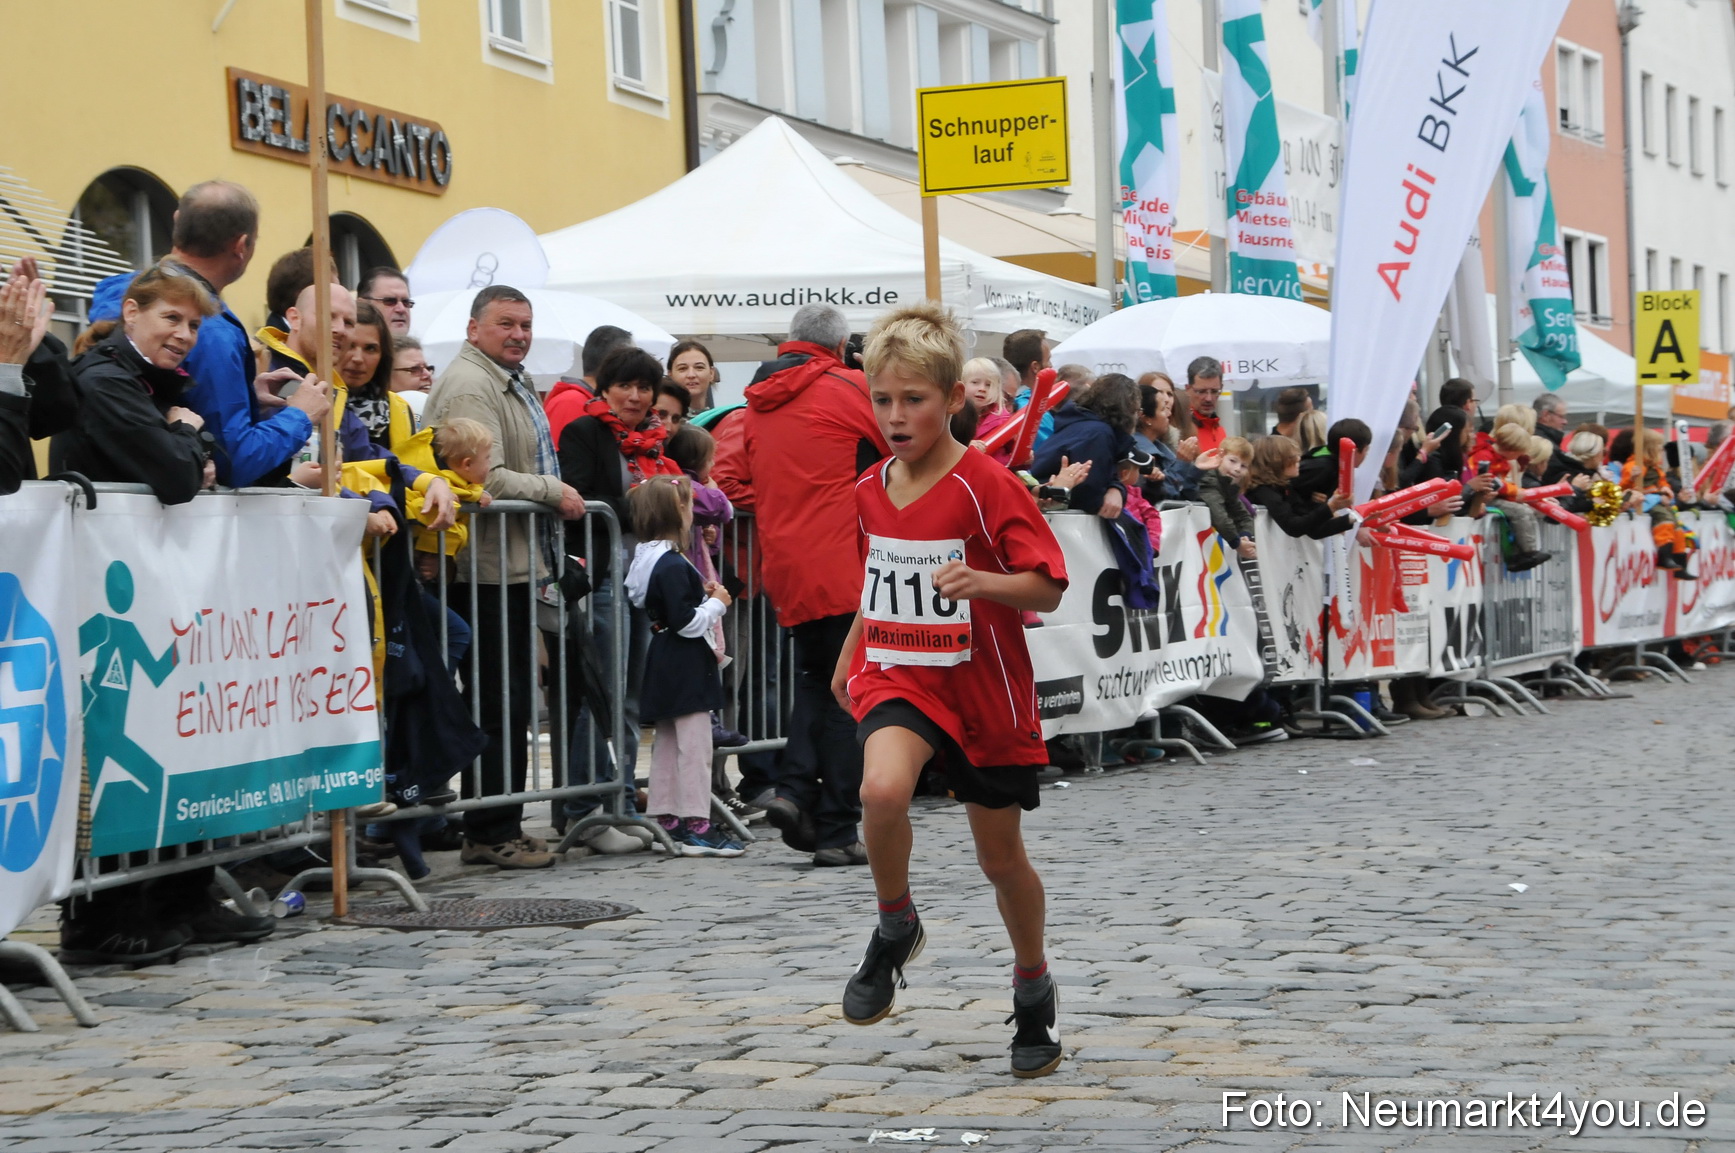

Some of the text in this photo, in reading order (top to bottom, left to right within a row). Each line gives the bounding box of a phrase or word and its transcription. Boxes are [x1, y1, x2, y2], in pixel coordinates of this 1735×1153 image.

[929, 114, 1057, 138] Schnupper-
[974, 142, 1014, 164] lauf
[1376, 31, 1480, 304] Audi BKK
[665, 286, 899, 307] www.audibkk.de
[983, 284, 1004, 308] Von
[1062, 300, 1081, 324] Audi
[1642, 294, 1693, 312] Block
[1648, 319, 1685, 364] A
[1237, 357, 1280, 374] BKK
[869, 547, 943, 566] RTL Neumarkt
[867, 566, 958, 618] 7118
[867, 624, 954, 648] Maximilian
[176, 788, 267, 821] Service-Line:
